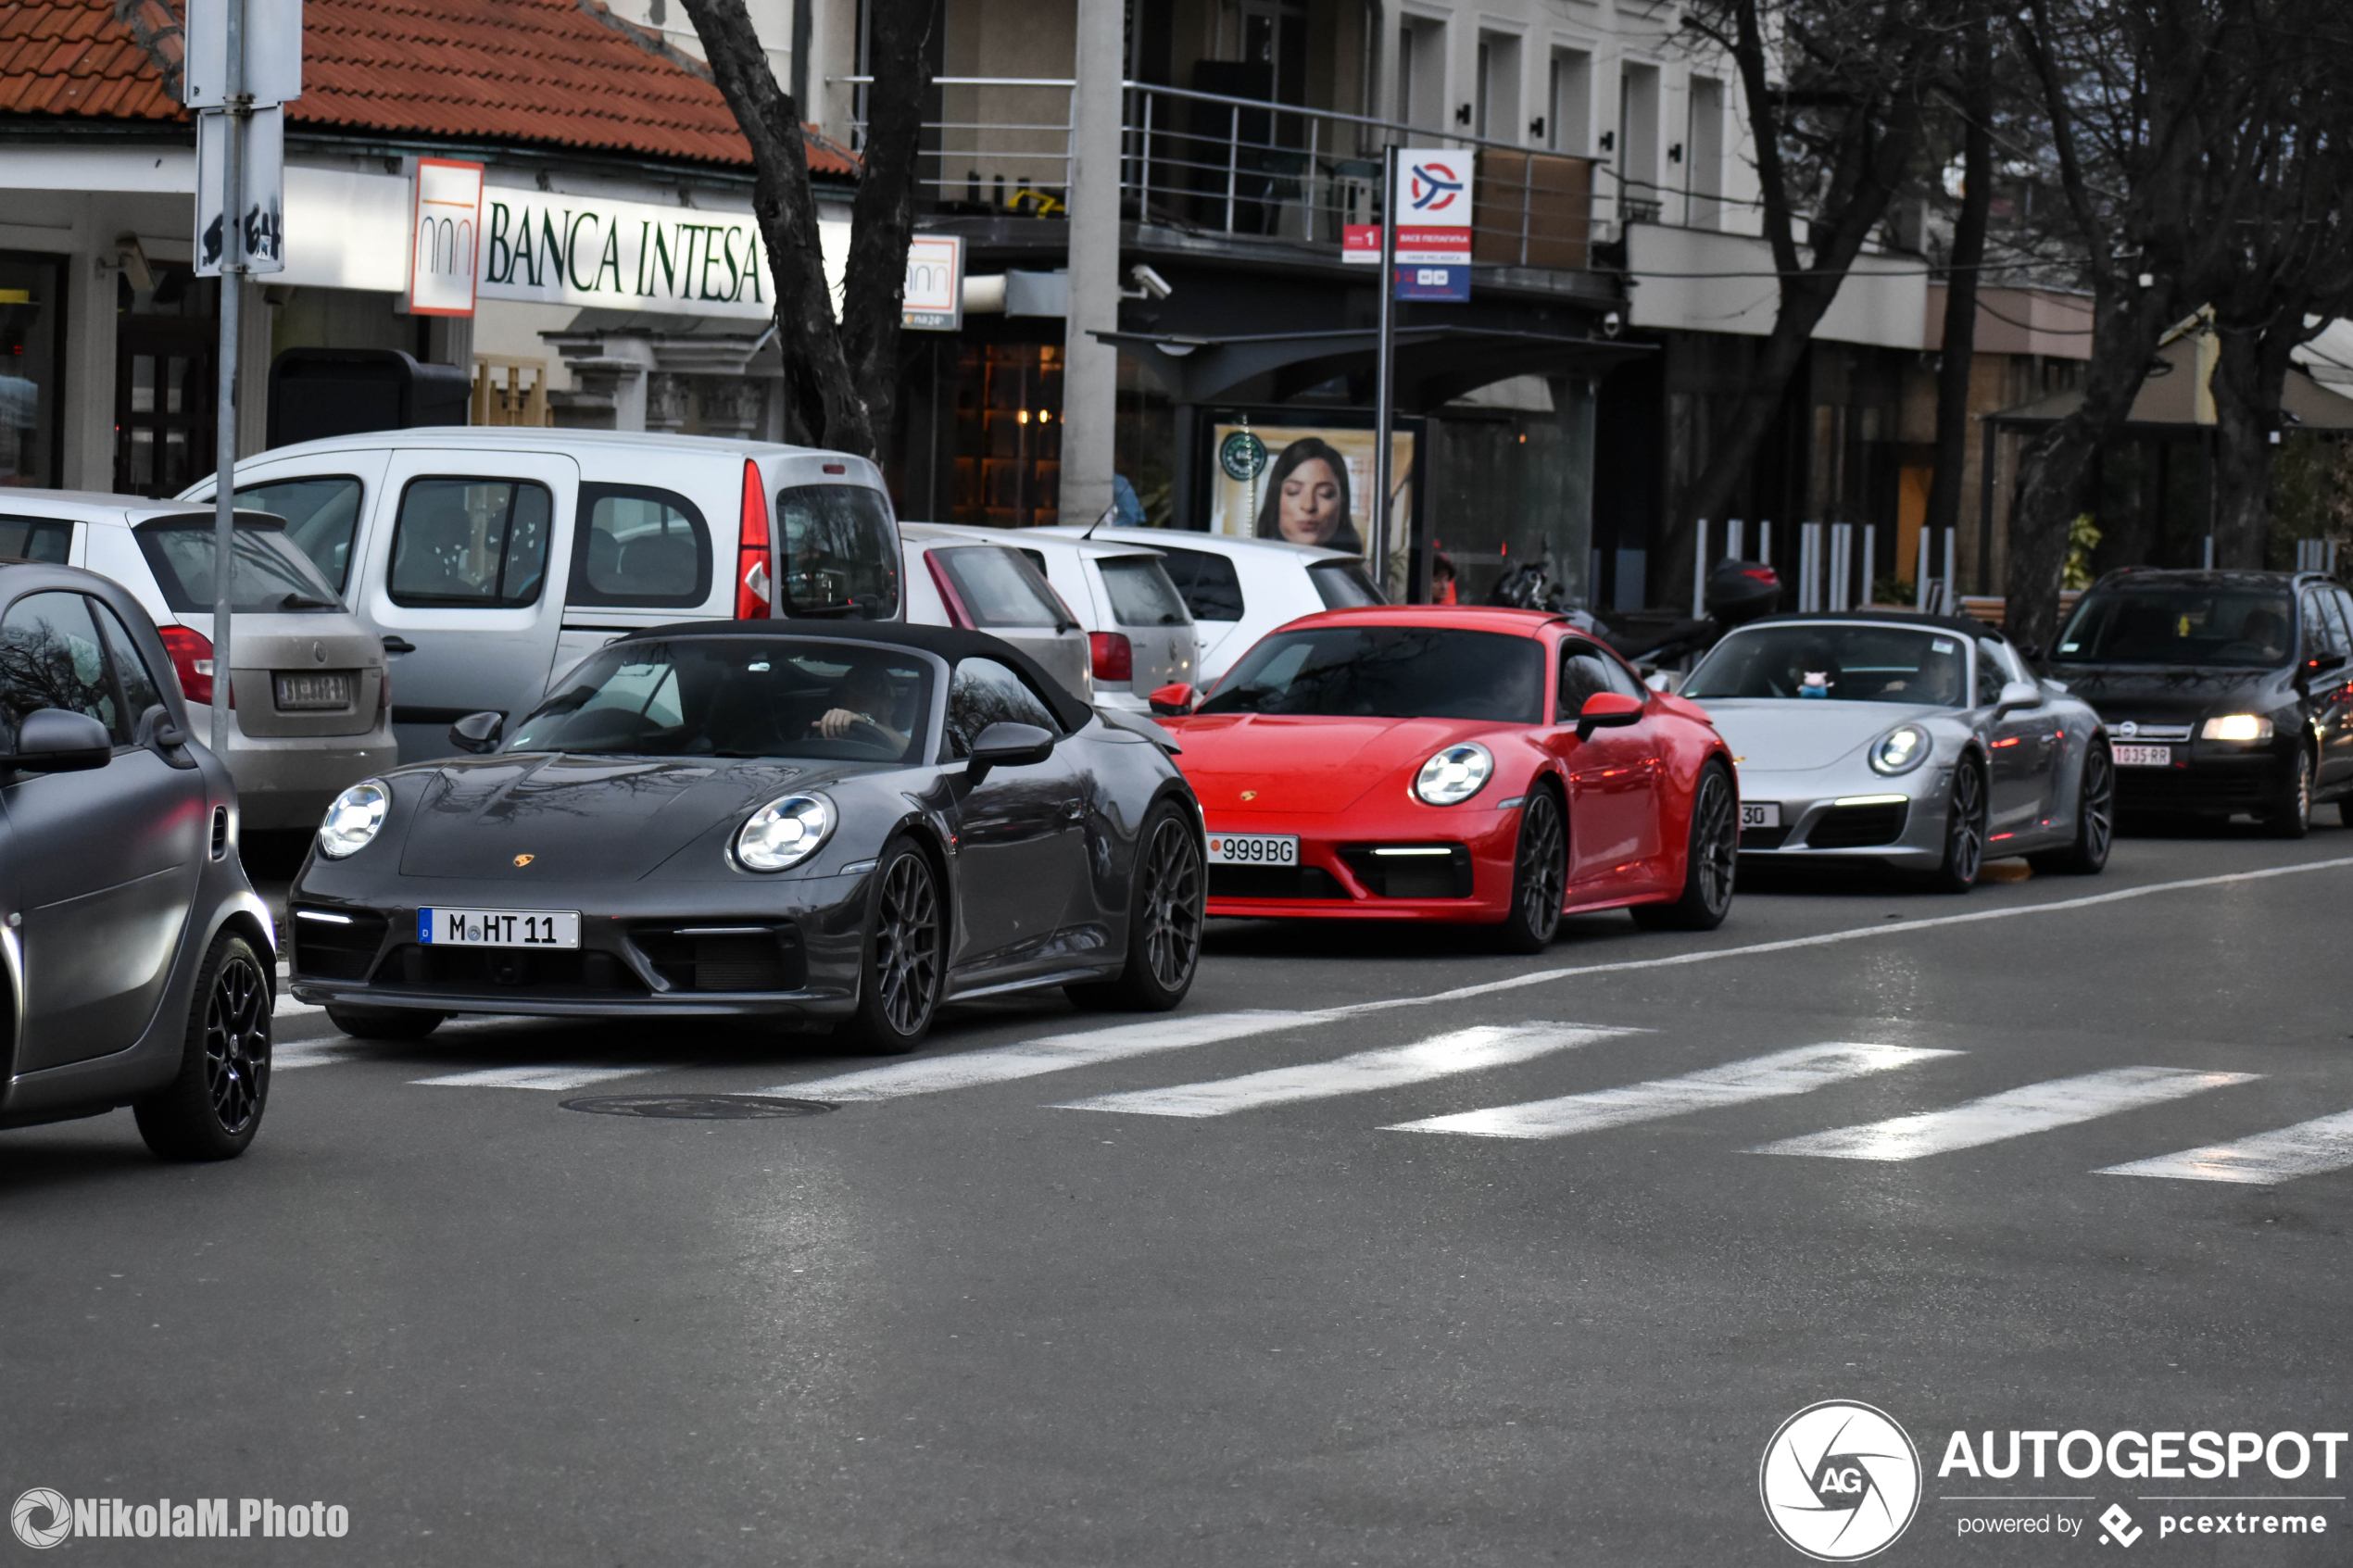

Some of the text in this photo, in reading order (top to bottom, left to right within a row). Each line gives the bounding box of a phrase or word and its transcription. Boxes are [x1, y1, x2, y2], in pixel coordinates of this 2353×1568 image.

[484, 202, 765, 304] BANCA INTESA
[1365, 231, 1375, 246] 1
